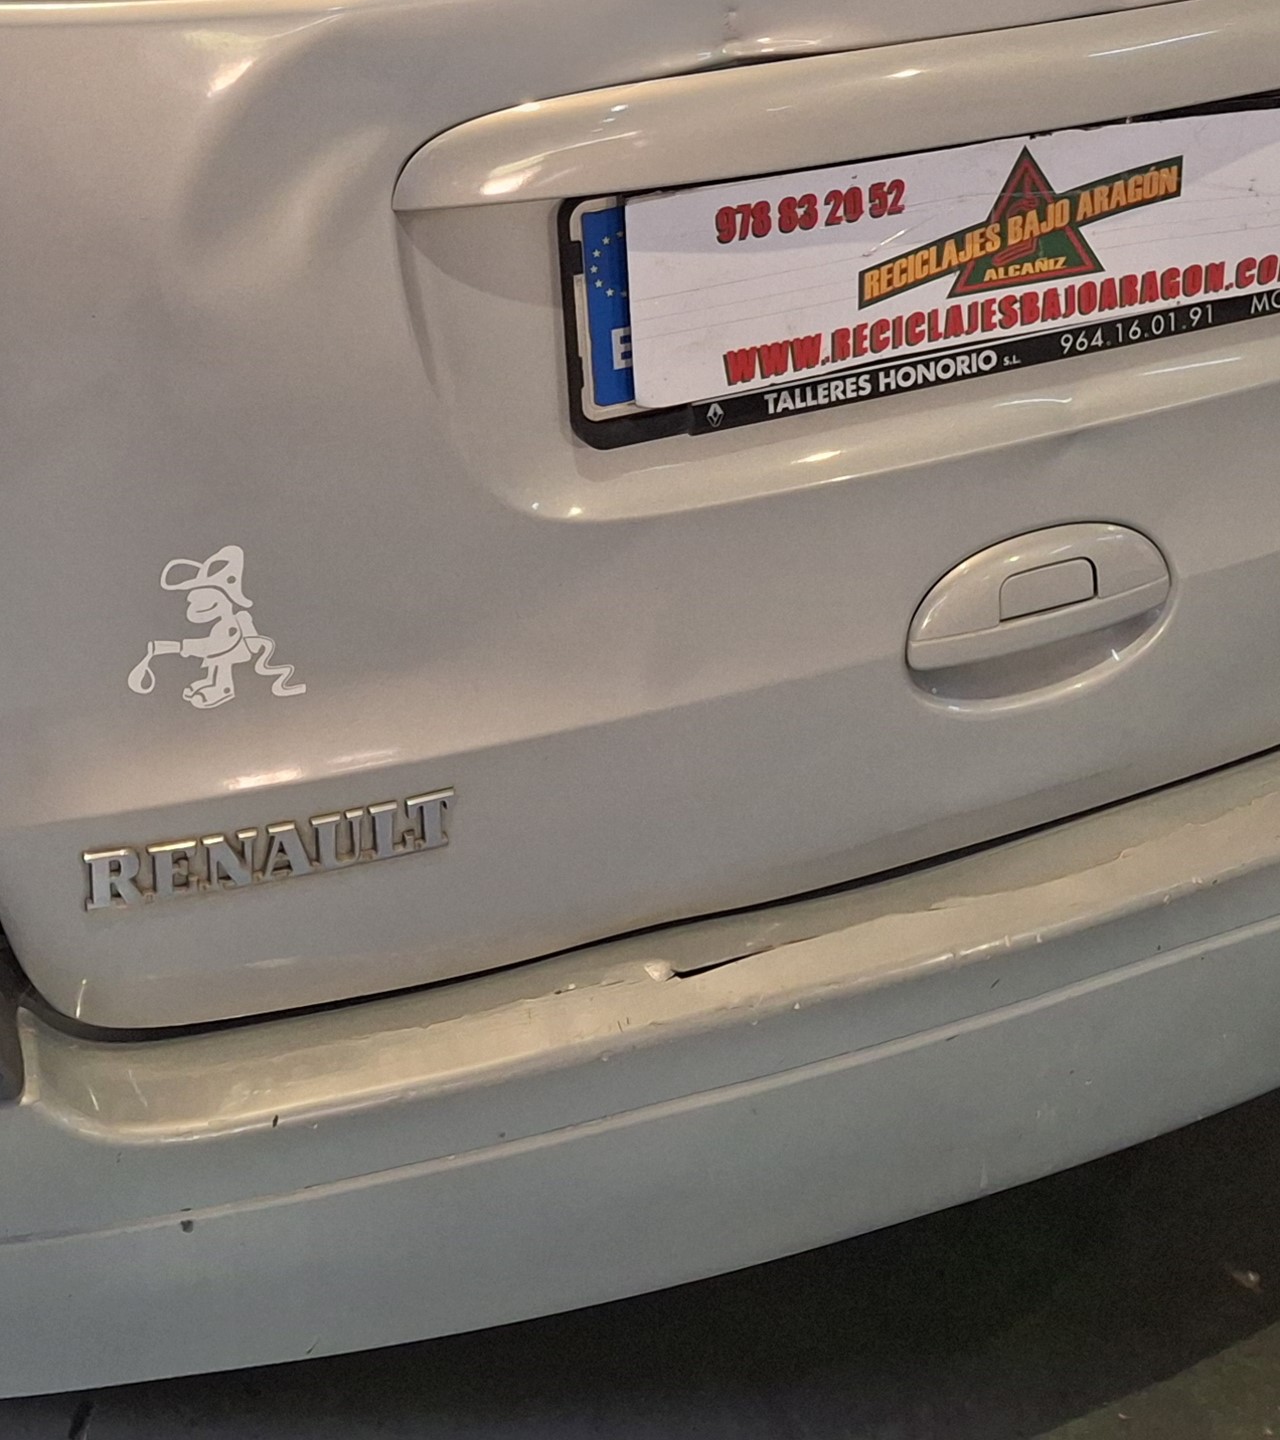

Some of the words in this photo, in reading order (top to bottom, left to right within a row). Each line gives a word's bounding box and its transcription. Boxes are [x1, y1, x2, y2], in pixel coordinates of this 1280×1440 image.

[715, 201, 771, 244] 978
[778, 193, 819, 233] 83
[824, 186, 864, 226] 20
[869, 179, 905, 218] 52
[863, 222, 1002, 302] RECICLAJES
[1007, 198, 1071, 247] BAJO
[1076, 166, 1179, 222] ARAGÓN
[982, 256, 1067, 283] ALCAÑIZ
[1060, 304, 1214, 355] 964.16.01.91
[764, 374, 872, 415] TALLERES
[878, 349, 998, 393] HONORIO
[81, 786, 456, 913] RENAULT
